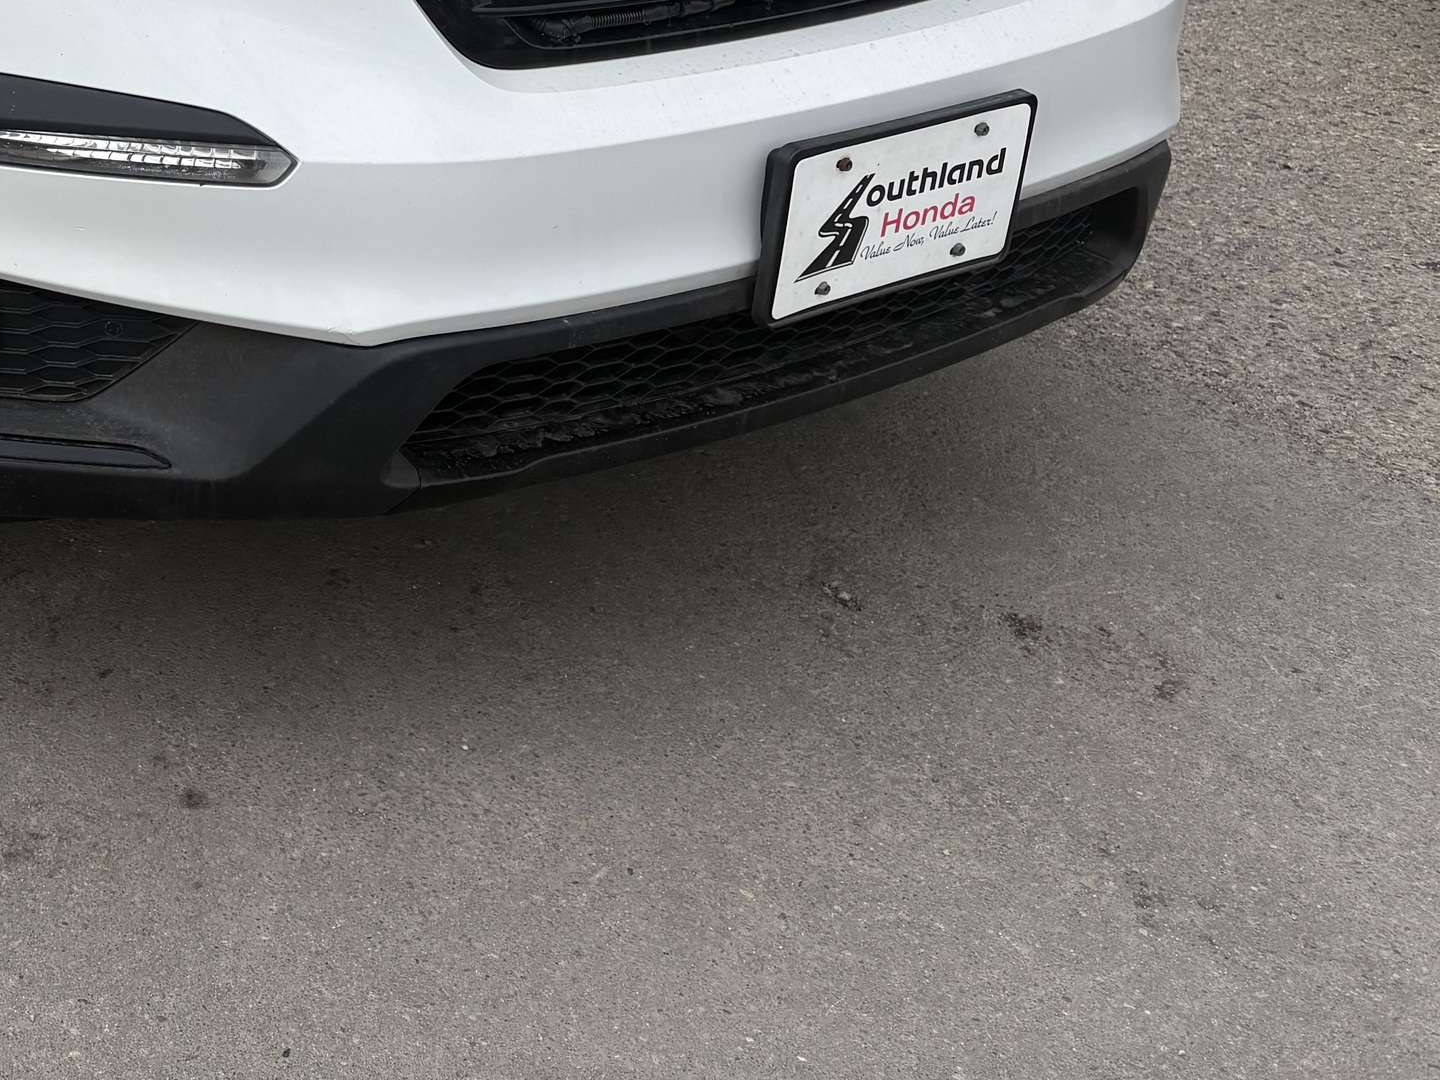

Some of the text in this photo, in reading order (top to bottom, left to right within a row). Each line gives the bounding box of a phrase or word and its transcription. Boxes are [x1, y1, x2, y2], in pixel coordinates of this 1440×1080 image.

[860, 241, 891, 260] Value
[929, 221, 959, 240] Value
[960, 211, 997, 233] Later!
[880, 193, 976, 238] Honda
